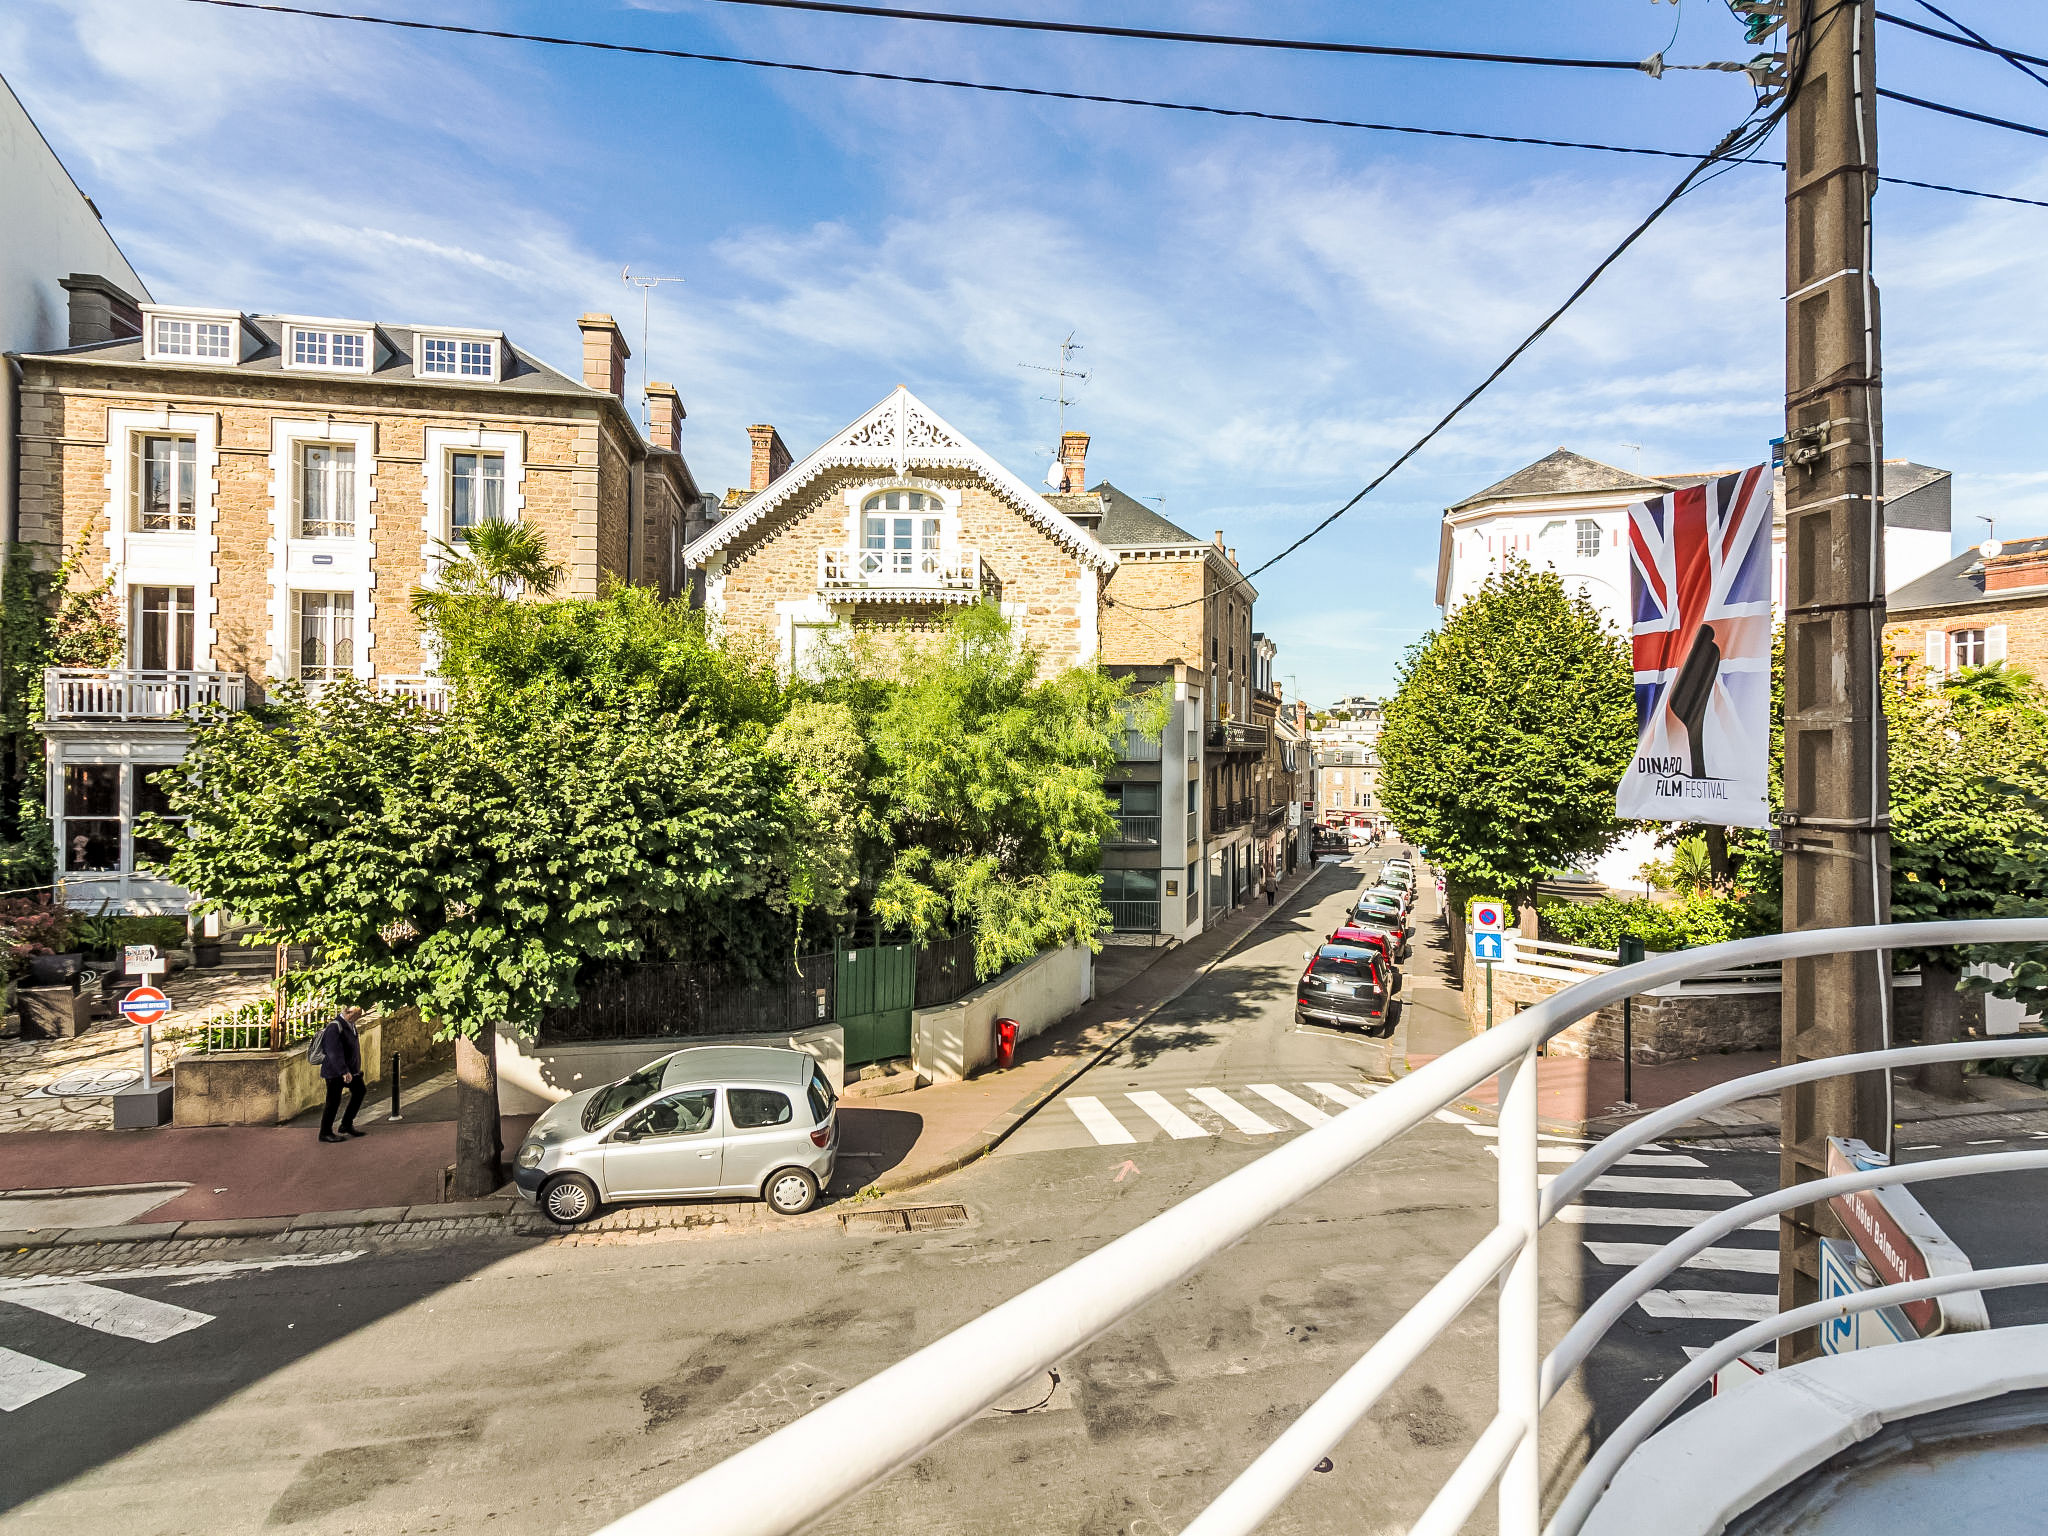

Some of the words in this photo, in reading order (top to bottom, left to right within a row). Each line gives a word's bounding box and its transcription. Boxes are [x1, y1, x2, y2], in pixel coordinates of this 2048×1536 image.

[1639, 757, 1682, 773] DINARD
[1656, 780, 1682, 797] FILM
[1685, 781, 1728, 799] FESTIVAL
[1855, 1196, 1873, 1236] Hôtel
[1874, 1221, 1907, 1281] Balmoral
